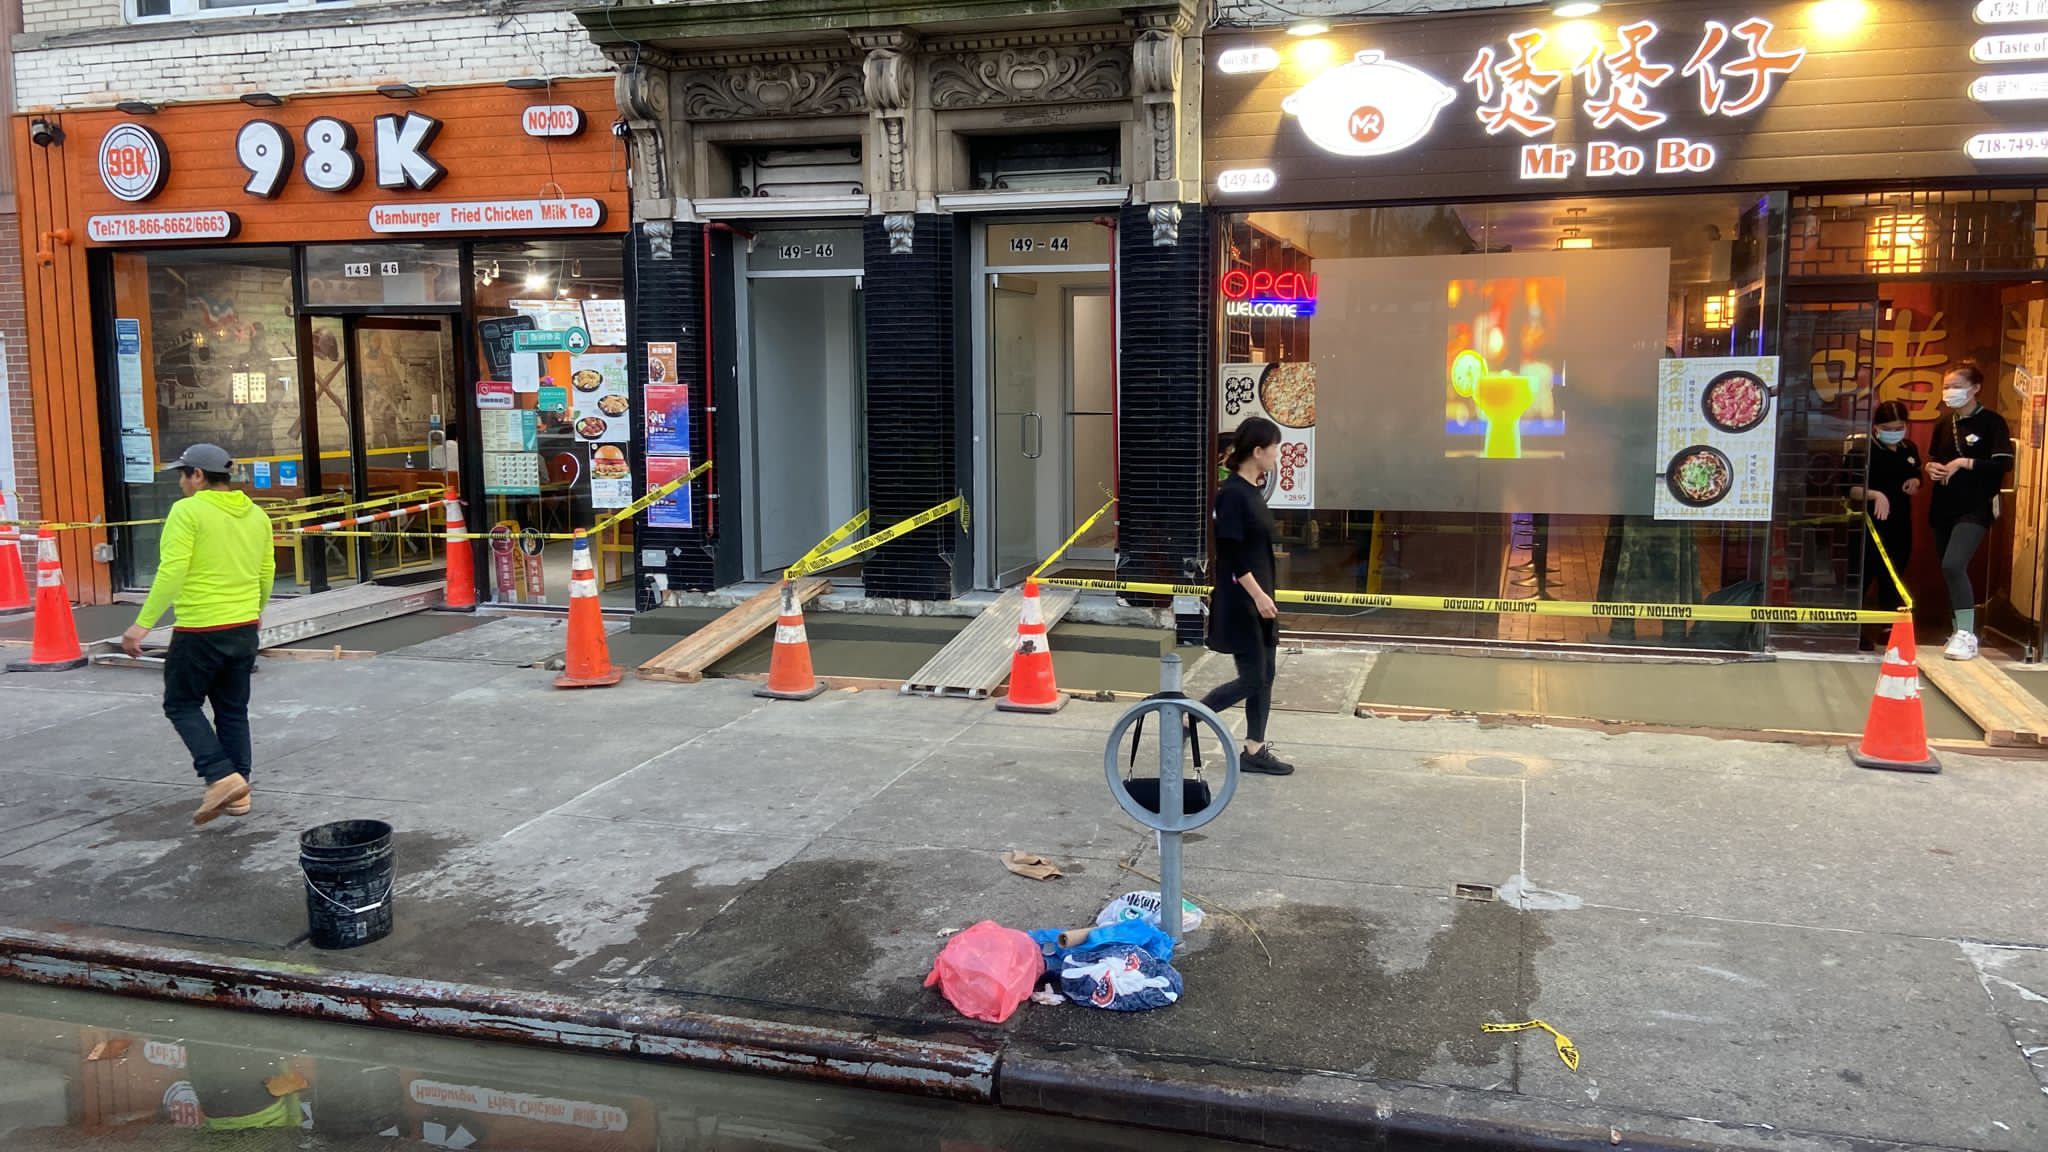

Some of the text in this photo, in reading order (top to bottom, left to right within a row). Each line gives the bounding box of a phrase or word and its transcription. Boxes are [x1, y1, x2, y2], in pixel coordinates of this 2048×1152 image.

[1984, 41, 1993, 55] A
[1999, 40, 2030, 54] Taste
[1466, 20, 1803, 136] 煲煲仔
[236, 110, 446, 198] 98K
[1522, 139, 1714, 177] Mr Bo Bo
[108, 147, 150, 178] 98K
[375, 204, 594, 227] Hamburger Fried Chicken Milk Tea
[93, 215, 225, 235] Tel:718-866-6662/6663
[346, 262, 398, 275] 149 46
[1222, 271, 1317, 300] OPEN
[1226, 301, 1297, 318] WELCOME
[1352, 595, 1392, 606] CAUTION
[1443, 599, 1485, 611] CUIDADO
[1495, 600, 1537, 612] CAUTION
[1591, 604, 1636, 616] CUIDADO
[1646, 606, 1692, 618] CAUTION
[1750, 609, 1798, 621] CUIDADO
[1809, 610, 1858, 622] CAUTION
